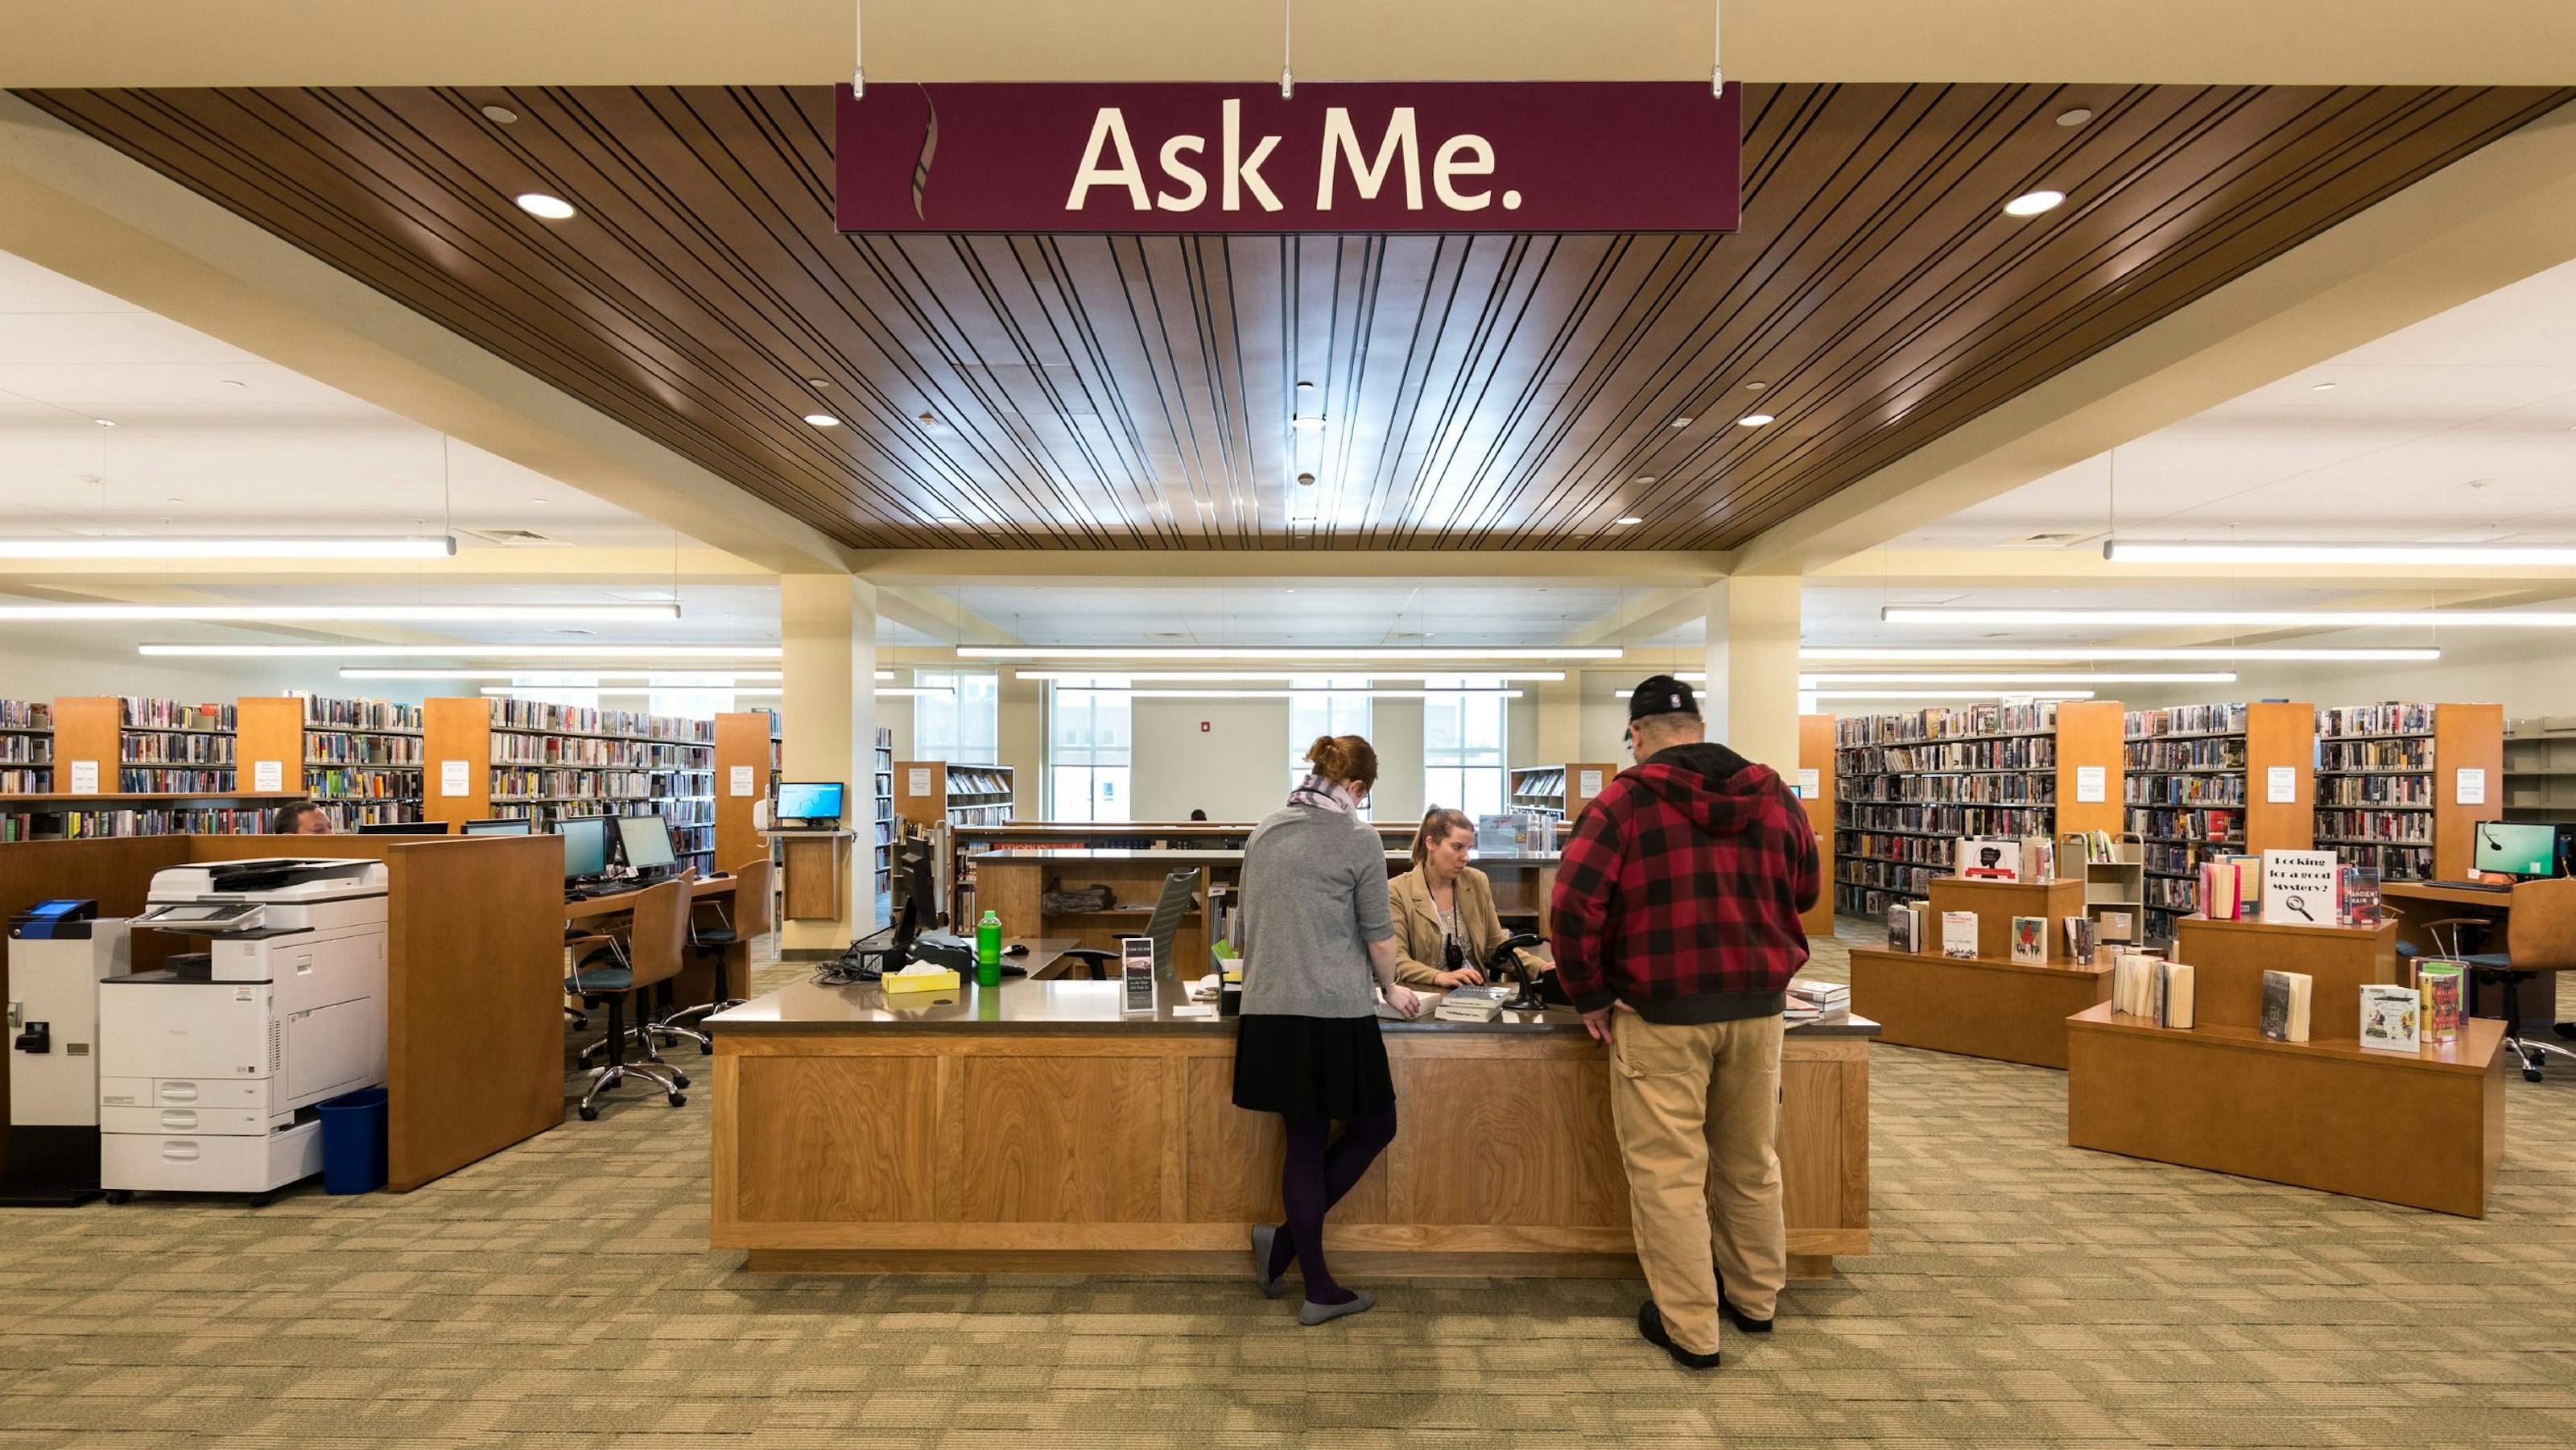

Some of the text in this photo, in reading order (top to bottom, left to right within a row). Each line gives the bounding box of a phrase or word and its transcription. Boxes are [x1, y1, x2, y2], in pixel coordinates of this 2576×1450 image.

[1065, 98, 1522, 213] Ask Me.
[2275, 857, 2326, 866] Looking
[2269, 870, 2288, 878] for
[2301, 872, 2330, 880] good
[2272, 883, 2328, 893] Mystery?
